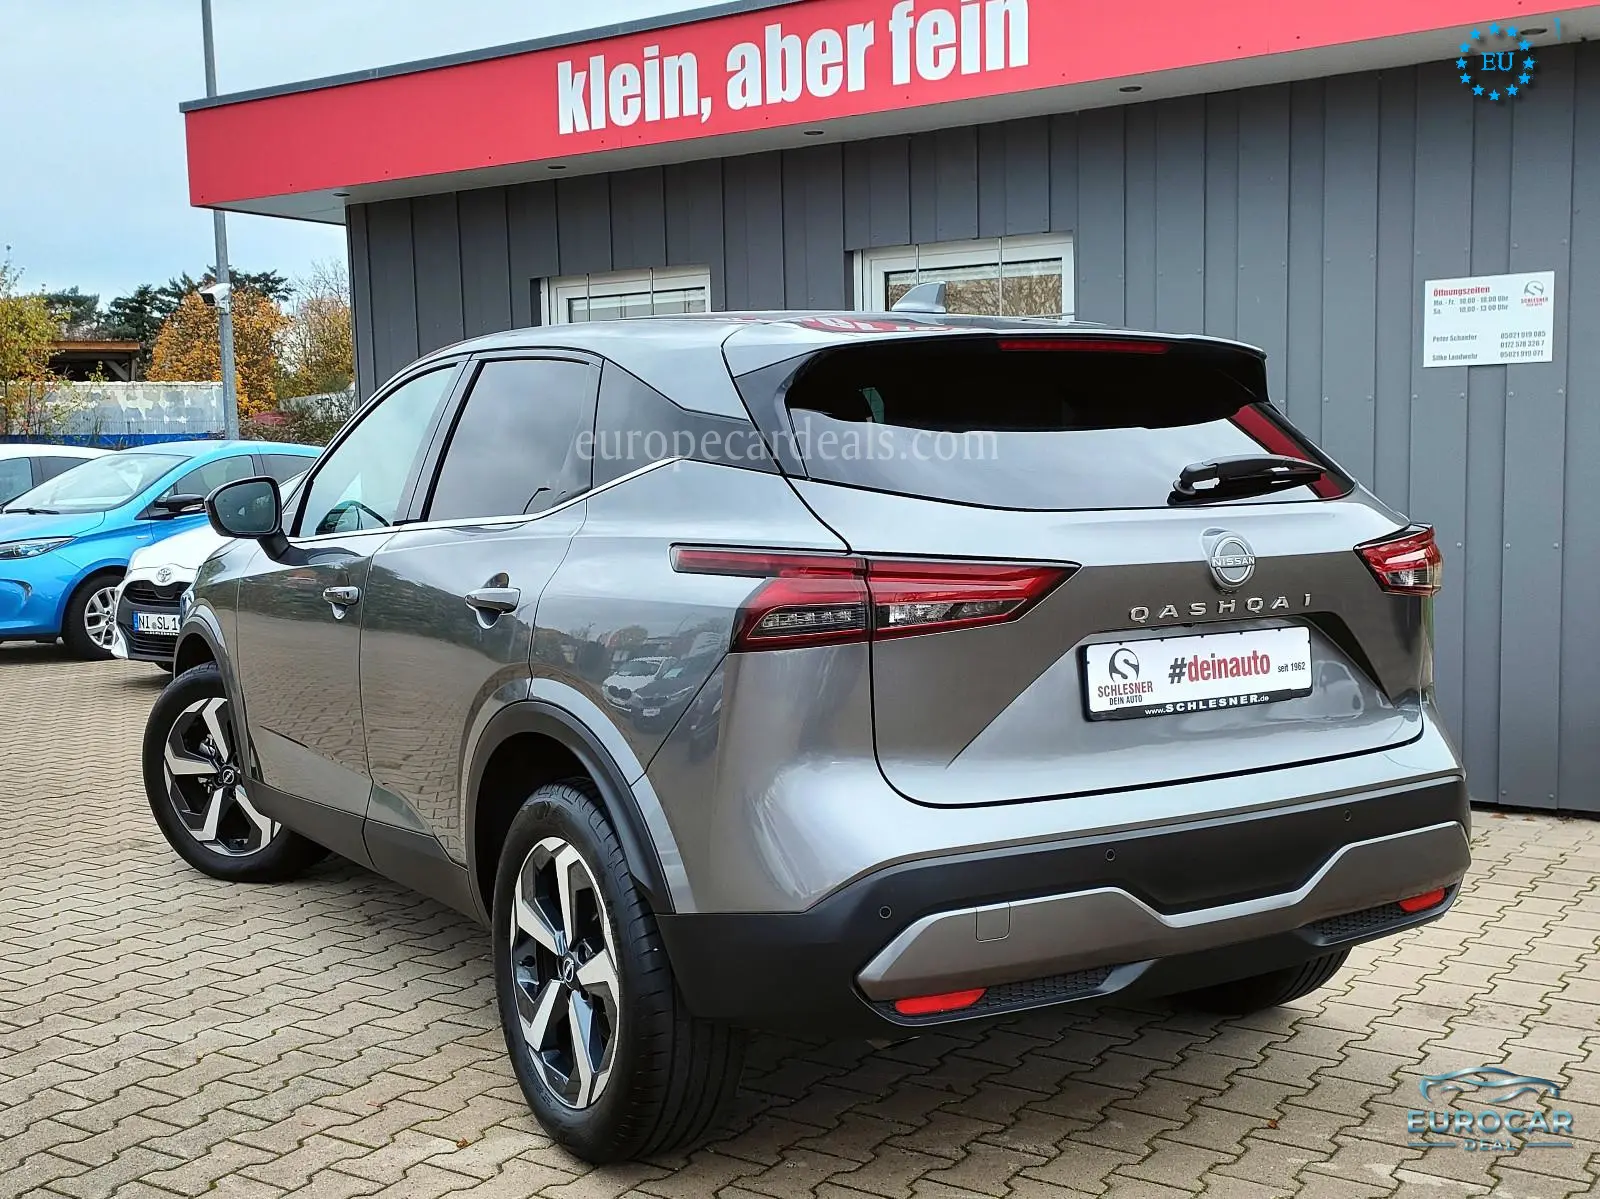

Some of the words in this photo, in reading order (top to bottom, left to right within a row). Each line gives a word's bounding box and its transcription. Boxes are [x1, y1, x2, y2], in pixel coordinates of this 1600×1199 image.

[557, 46, 712, 135] klein,
[726, 21, 875, 110] aber
[889, 0, 1029, 86] fein
[1433, 286, 1490, 297] Öffnungszeiten
[1211, 556, 1255, 567] NISSAN
[1130, 593, 1312, 623] QASHQAI
[138, 615, 149, 629] NI
[157, 616, 170, 630] SL
[1168, 650, 1271, 684] #deinauto
[1277, 664, 1289, 673] seit
[1290, 661, 1306, 672] 1962
[1097, 680, 1154, 698] SCHLESNER
[1109, 696, 1125, 706] DEIN
[1126, 694, 1143, 704] AUTO
[1145, 694, 1270, 715] www.SCHLESNER.de
